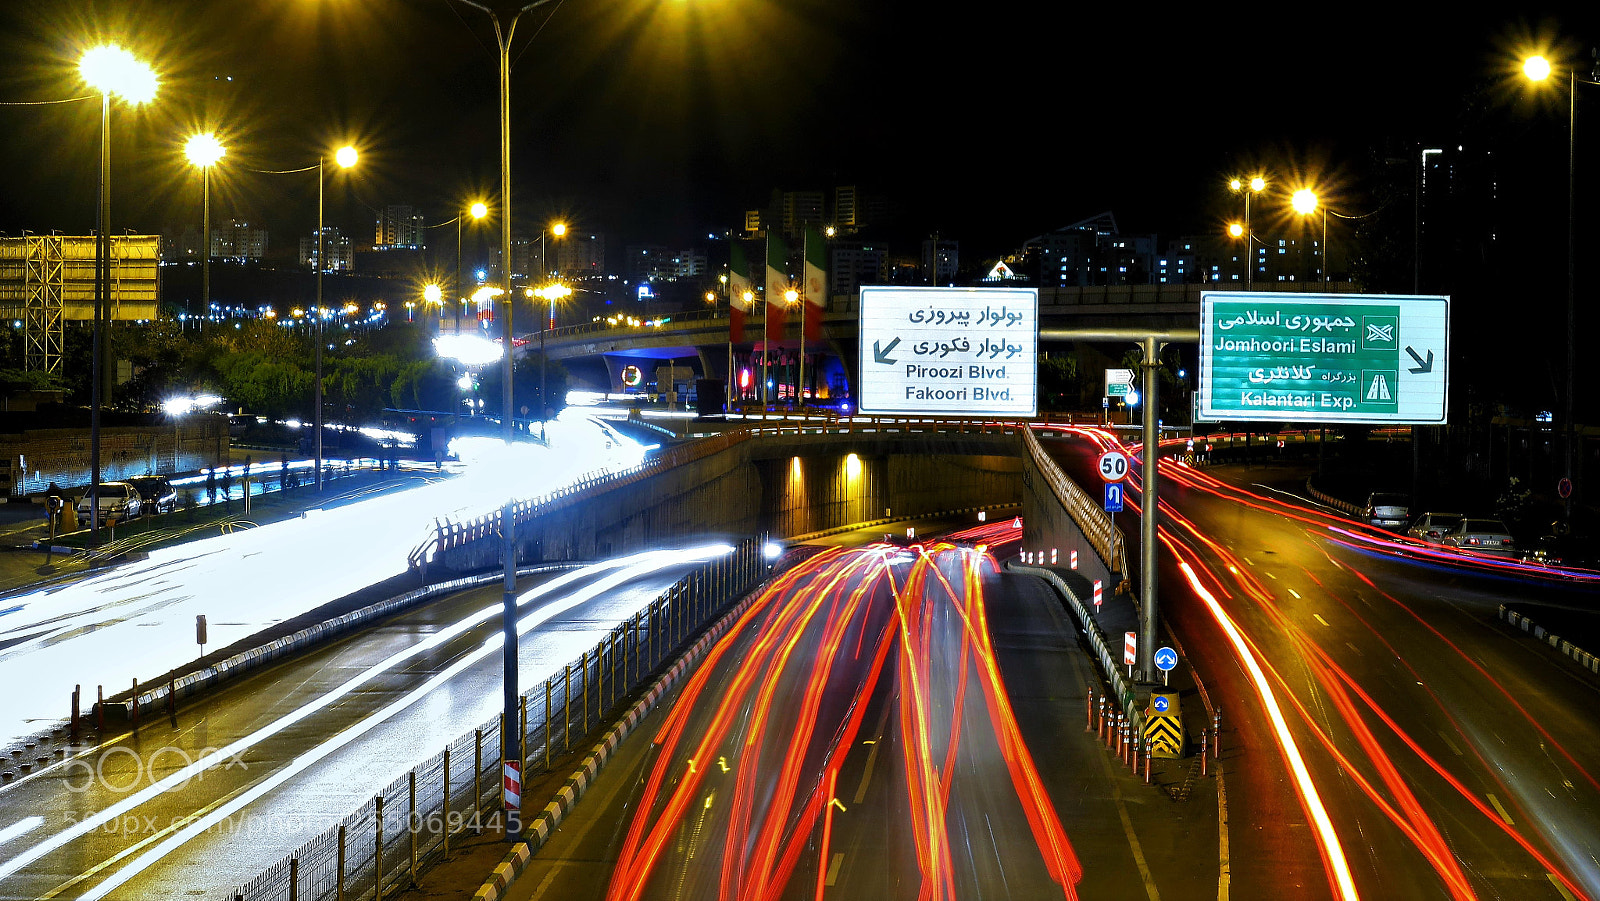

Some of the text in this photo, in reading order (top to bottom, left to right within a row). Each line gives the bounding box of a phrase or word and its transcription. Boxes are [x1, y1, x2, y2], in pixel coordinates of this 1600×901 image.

[908, 305, 1023, 327] بولوار پیروزی
[1218, 310, 1356, 333] جمهوری اسلامی
[913, 336, 1023, 359] بولوار فکوری
[1215, 336, 1356, 354] Jomhoori Eslami
[906, 364, 1010, 379] Piroozi Blvd.
[1248, 364, 1357, 385] بزرگراه کلانتری
[905, 386, 1014, 401] Fakoori Blvd.
[1241, 391, 1357, 412] Kalantari Exp.
[1102, 457, 1125, 475] 50
